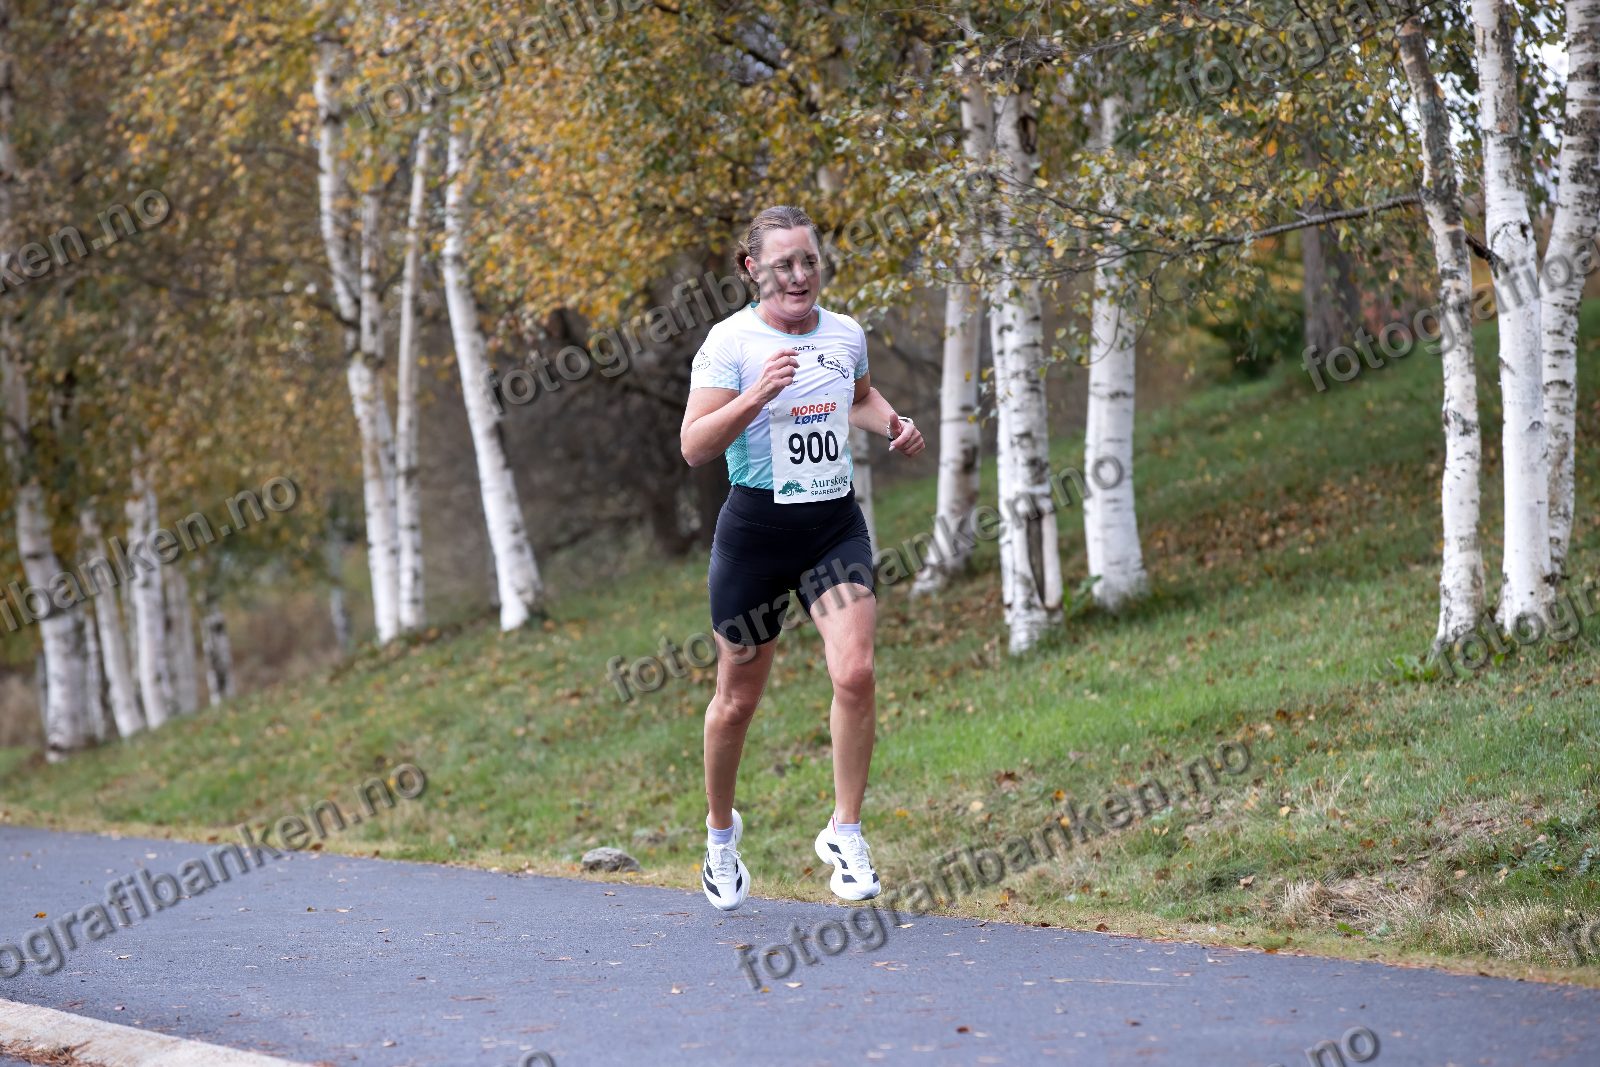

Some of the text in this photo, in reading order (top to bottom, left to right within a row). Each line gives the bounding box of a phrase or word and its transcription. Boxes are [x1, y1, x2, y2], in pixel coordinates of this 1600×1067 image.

[790, 402, 837, 417] NORGES
[794, 412, 830, 425] LØPET
[788, 430, 839, 465] 900
[810, 475, 848, 489] Aurskog
